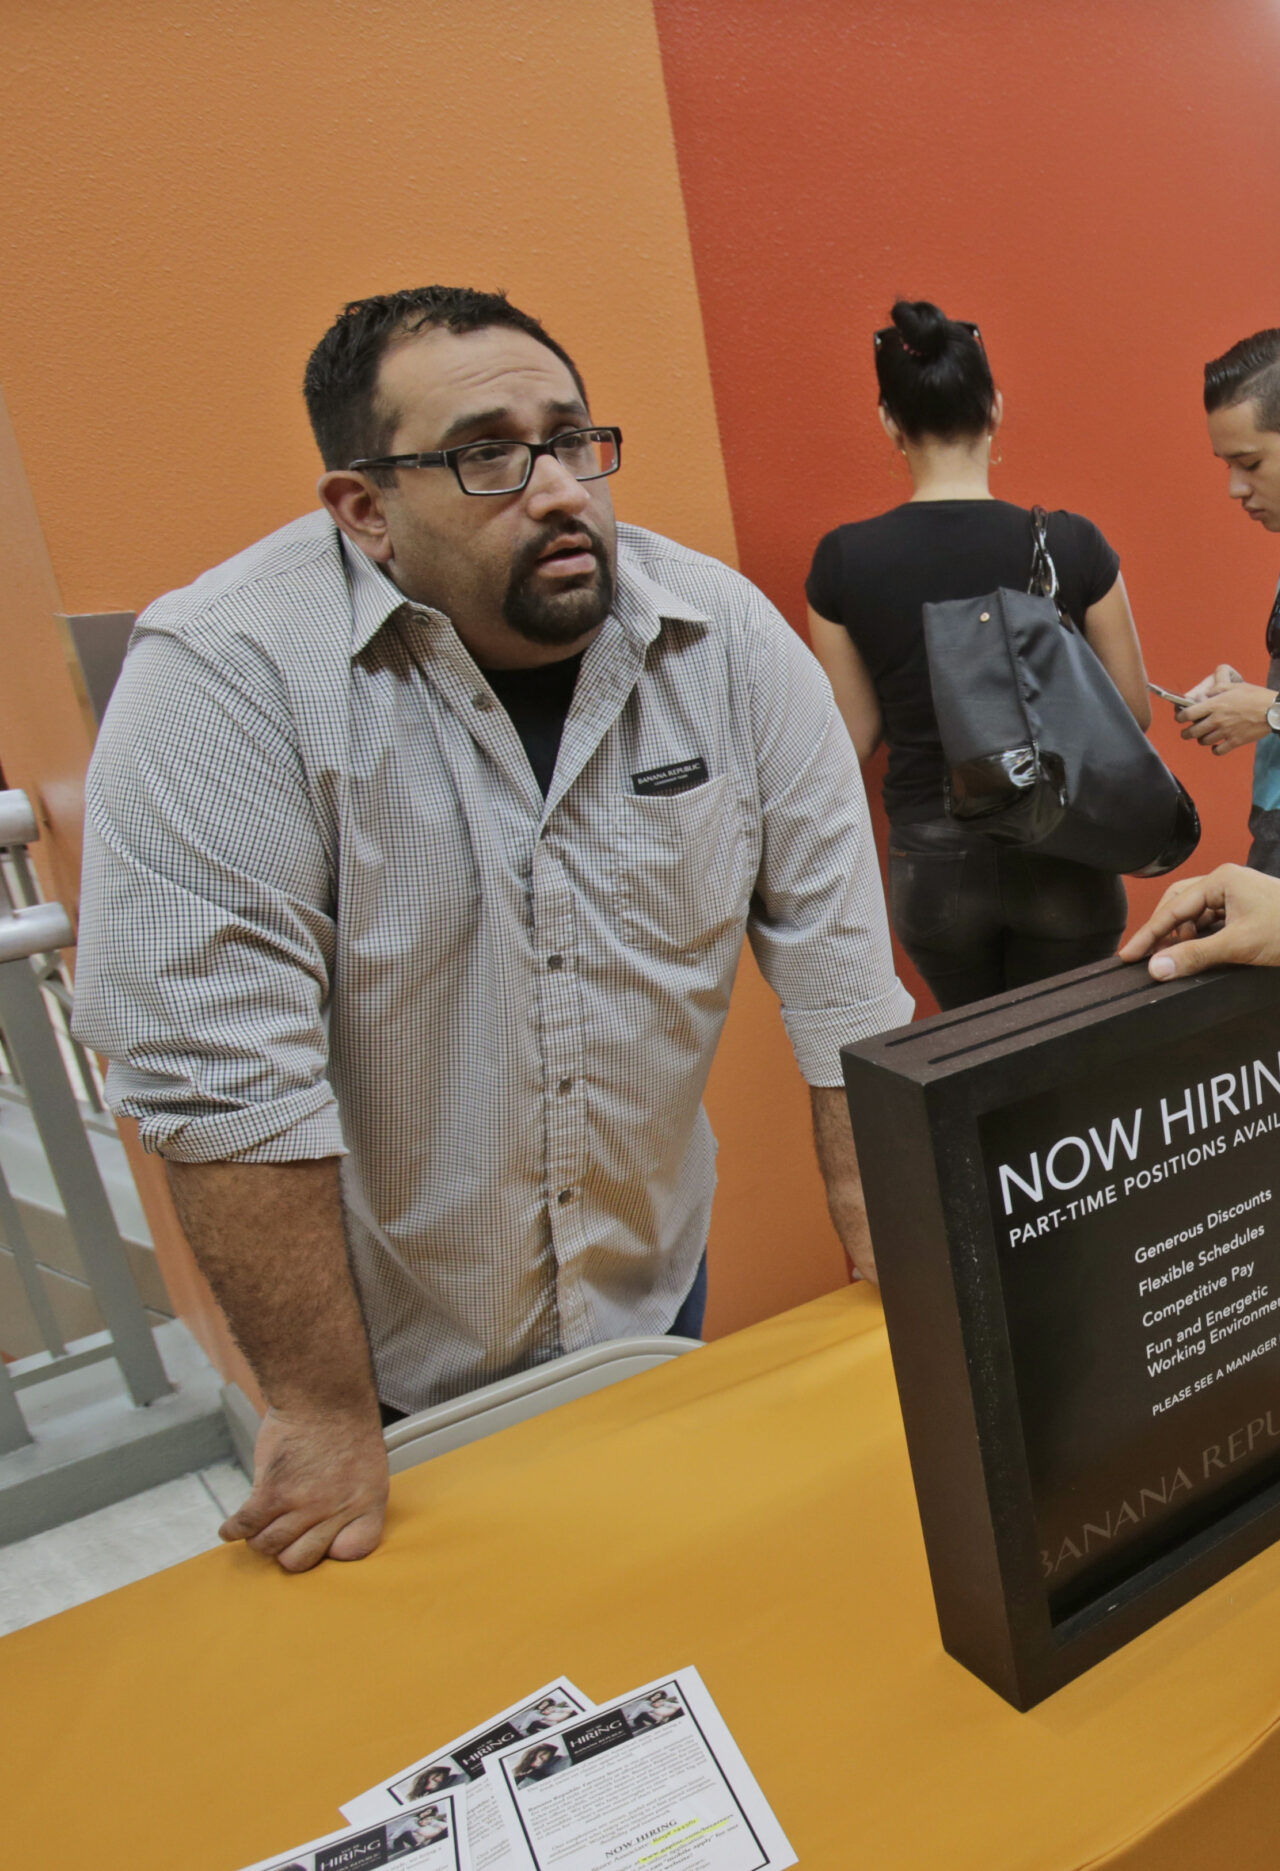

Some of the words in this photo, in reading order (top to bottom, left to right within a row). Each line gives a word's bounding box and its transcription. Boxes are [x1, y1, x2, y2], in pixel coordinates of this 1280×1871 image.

[998, 1107, 1143, 1216] NOW
[1008, 1184, 1118, 1249] PART-TIME
[1123, 1135, 1227, 1196] POSITIONS
[1134, 1222, 1204, 1264] Generous
[1206, 1189, 1273, 1230] Discounts
[1138, 1259, 1195, 1297] Flexible
[1197, 1224, 1265, 1267] Schedules
[1142, 1276, 1228, 1328] Competitive
[1231, 1259, 1256, 1285] Pay
[1145, 1337, 1173, 1360] Fun
[1176, 1316, 1202, 1343] and
[1205, 1285, 1269, 1327] Energetic
[1146, 1339, 1207, 1378] Working
[1152, 1385, 1193, 1417] PLEASE
[1193, 1373, 1214, 1393] SEE
[1215, 1368, 1225, 1381] A
[1225, 1336, 1278, 1374] MANAGER
[462, 1732, 515, 1766] HIRING
[569, 1719, 623, 1748] HIRING
[320, 1840, 382, 1871] HIRING
[604, 1840, 634, 1858] NOW
[636, 1820, 678, 1845] HIRING
